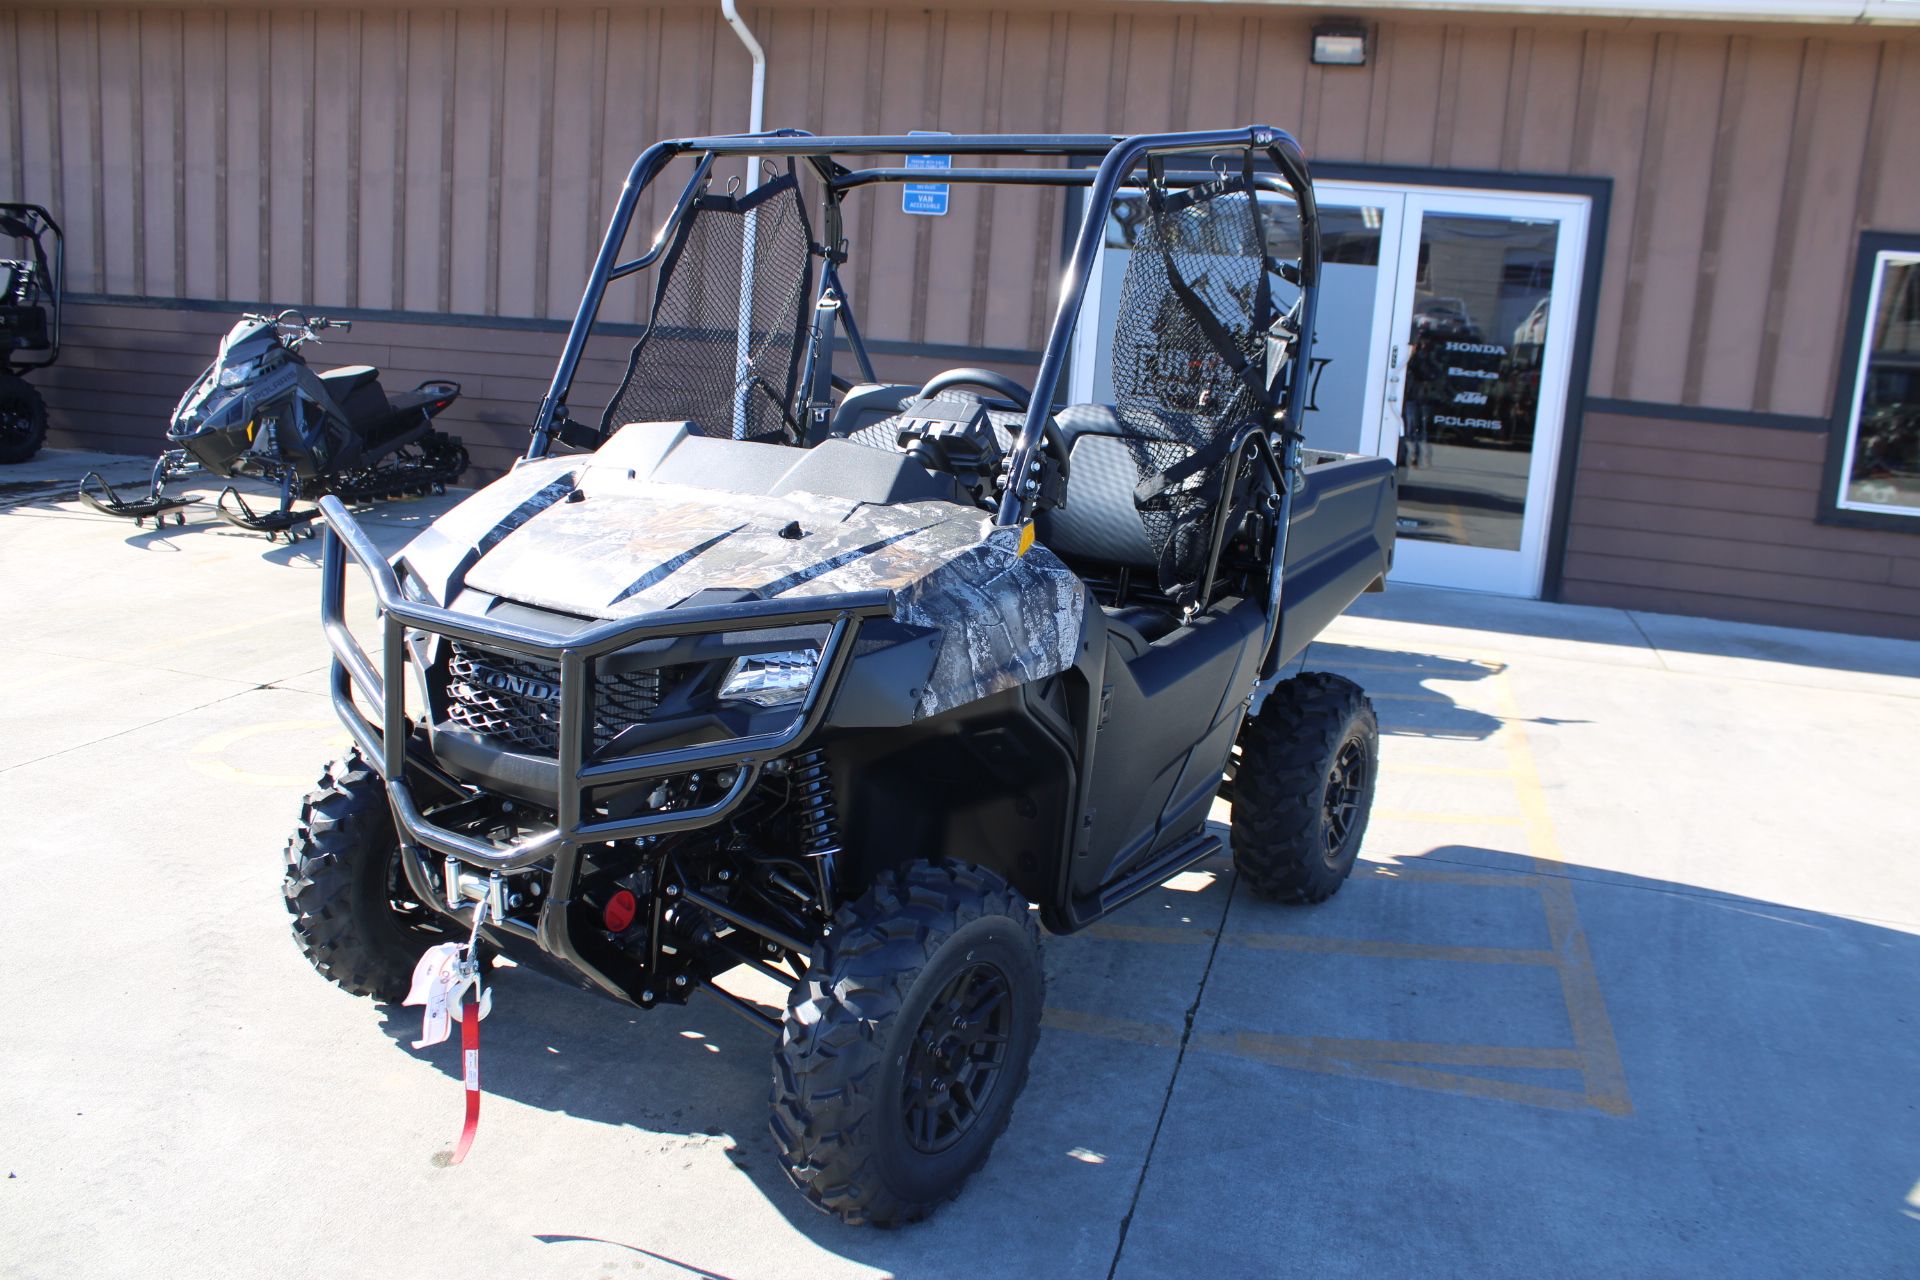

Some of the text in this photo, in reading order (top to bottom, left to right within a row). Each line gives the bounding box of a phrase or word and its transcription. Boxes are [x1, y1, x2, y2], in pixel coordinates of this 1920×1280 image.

[918, 194, 934, 203] VAN
[1445, 341, 1508, 355] HONDA
[1448, 366, 1500, 379] Beta
[1454, 391, 1489, 405] KTM
[1433, 415, 1503, 430] POLARIS
